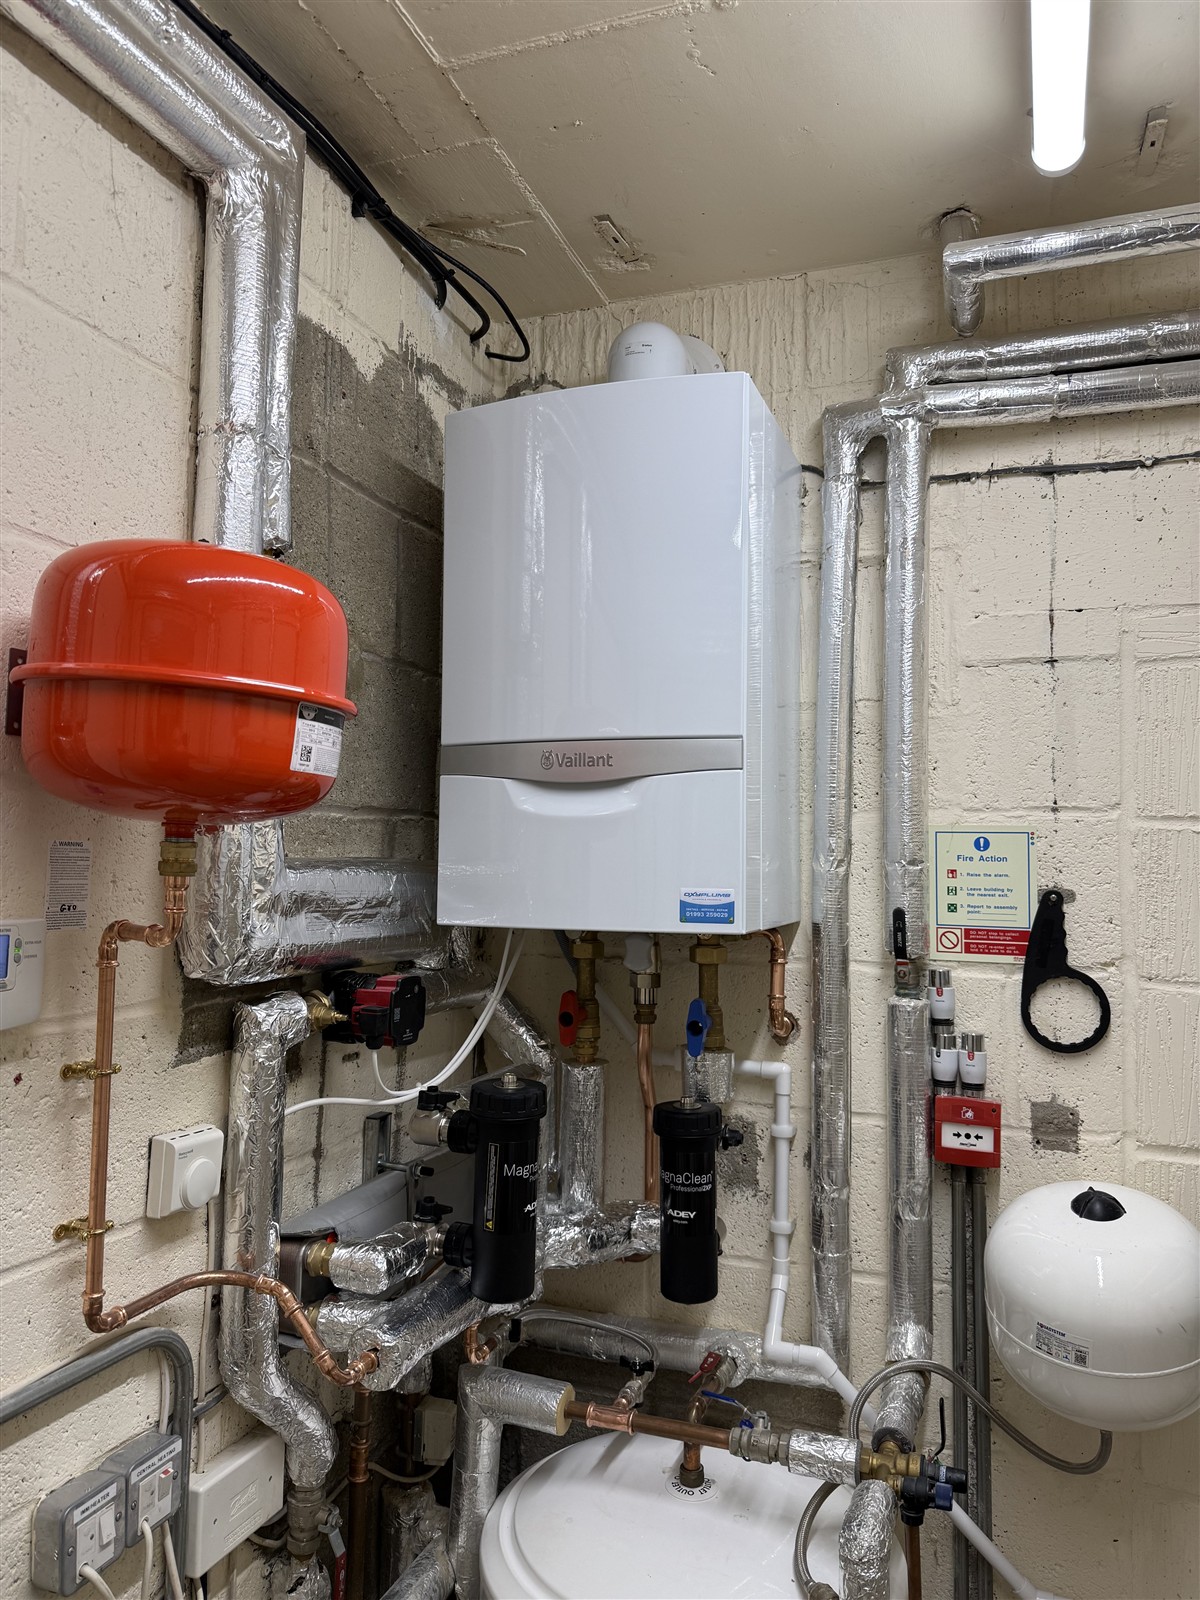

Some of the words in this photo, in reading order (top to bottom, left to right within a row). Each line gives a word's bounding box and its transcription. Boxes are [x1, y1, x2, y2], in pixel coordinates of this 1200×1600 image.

[556, 752, 613, 767] Vaillant
[661, 1170, 712, 1184] agnaClean
[667, 1209, 696, 1218] ADEY
[136, 1462, 156, 1477] CENTRAL
[158, 1447, 176, 1463] HEATING
[672, 1482, 694, 1496] OUTLET
